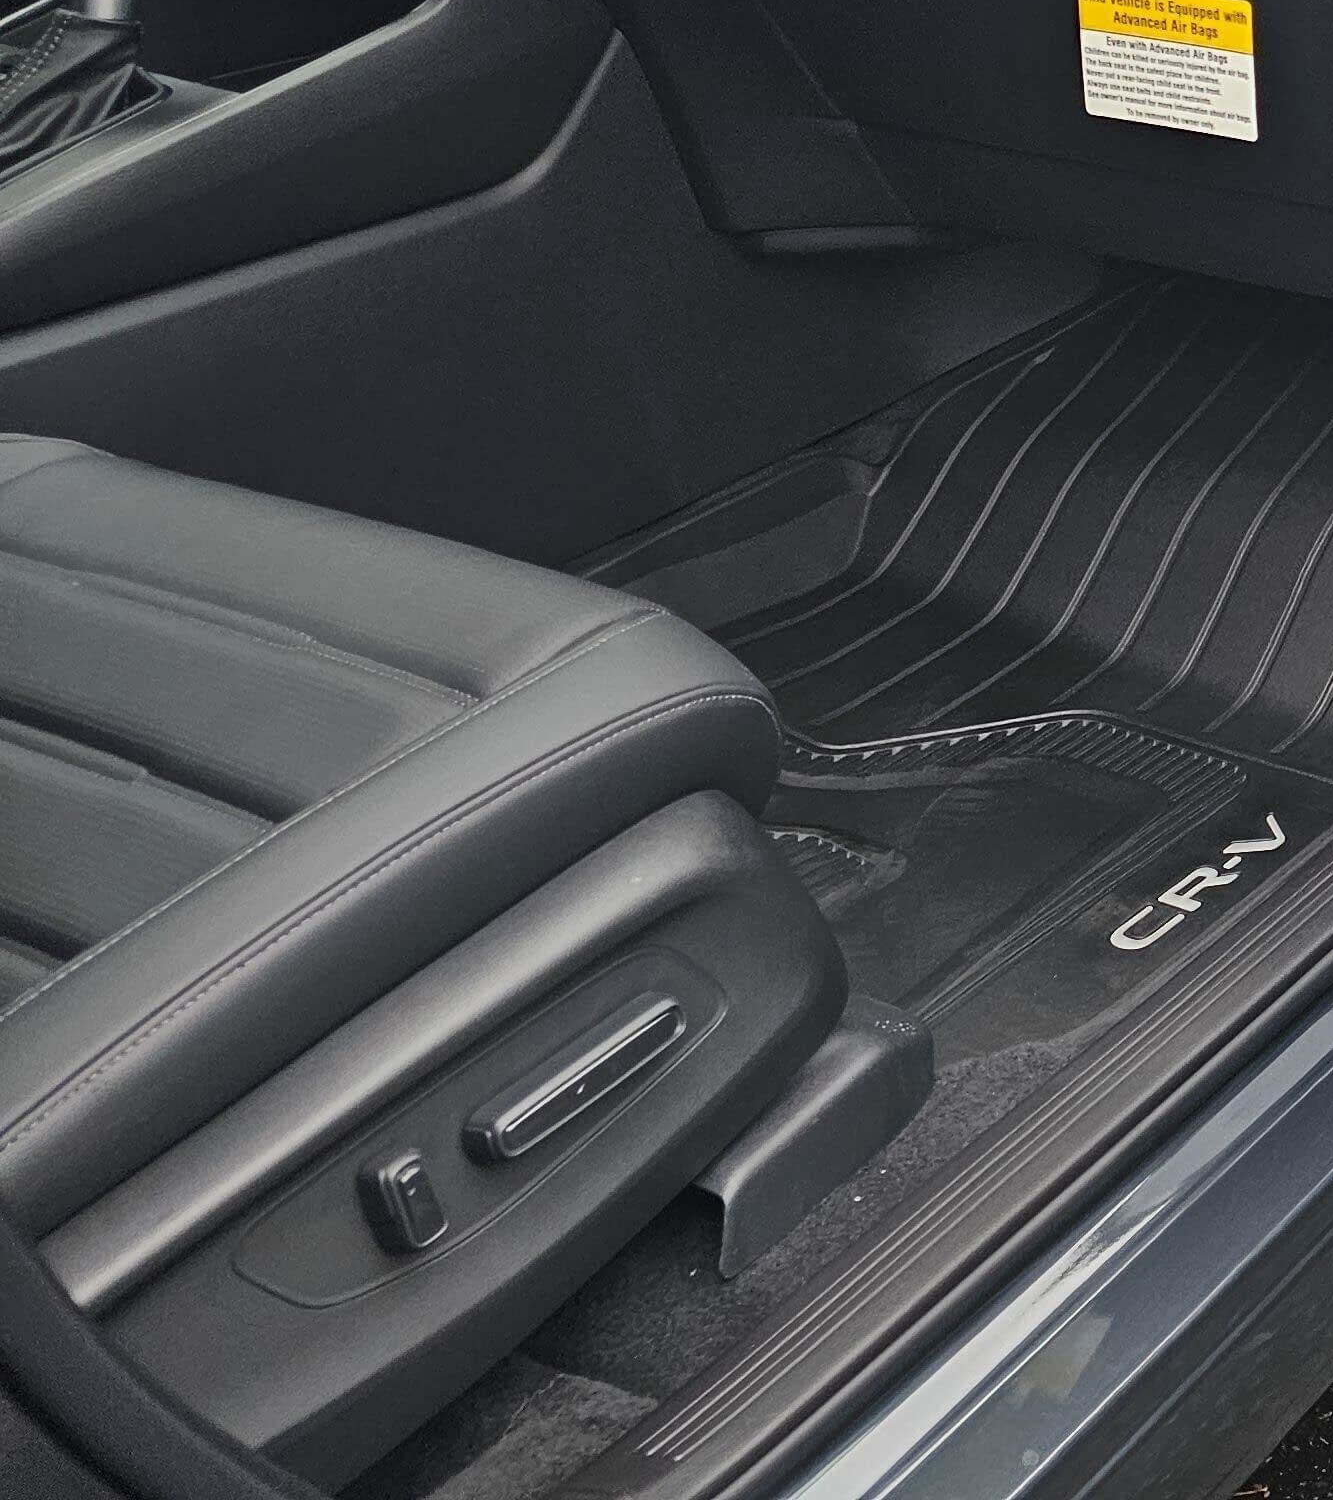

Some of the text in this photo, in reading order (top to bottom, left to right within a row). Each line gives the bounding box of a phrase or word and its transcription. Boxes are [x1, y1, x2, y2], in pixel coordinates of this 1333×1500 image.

[1168, 0, 1220, 21] Equipped
[1224, 10, 1248, 25] with
[1113, 11, 1219, 41] Advanced Air Bags
[1085, 46, 1110, 58] Children
[1132, 53, 1149, 63] killed
[1086, 57, 1097, 66] The
[1099, 59, 1112, 68] back
[1106, 36, 1229, 66] Even with Advanced Air Bags
[1087, 79, 1109, 90] Always
[1110, 812, 1286, 950] CR-V
